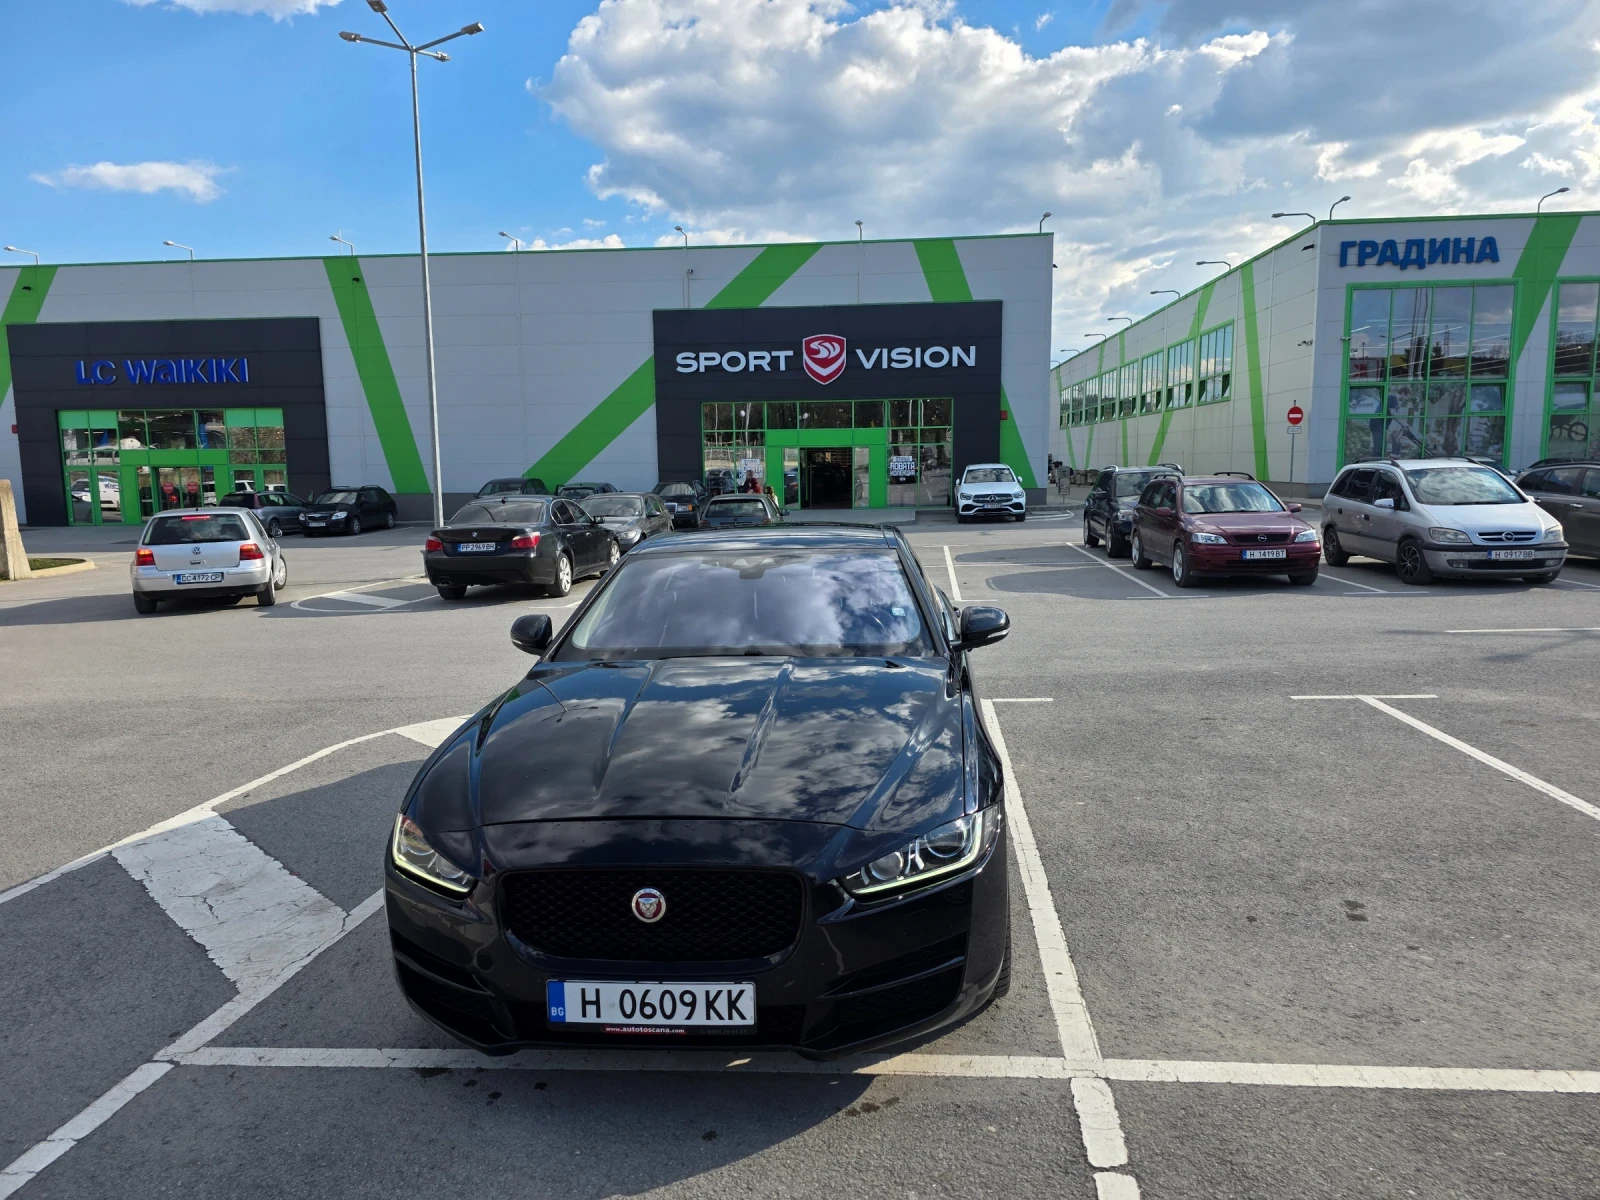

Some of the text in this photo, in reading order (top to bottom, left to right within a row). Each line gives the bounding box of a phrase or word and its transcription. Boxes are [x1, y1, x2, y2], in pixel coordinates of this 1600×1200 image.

[1339, 236, 1499, 270] ГРАДИНА
[675, 350, 794, 373] SPORT
[855, 345, 977, 369] VISION
[76, 360, 117, 385] LC
[551, 1006, 565, 1016] BG
[605, 1026, 685, 1034] www.autotoscana.com
